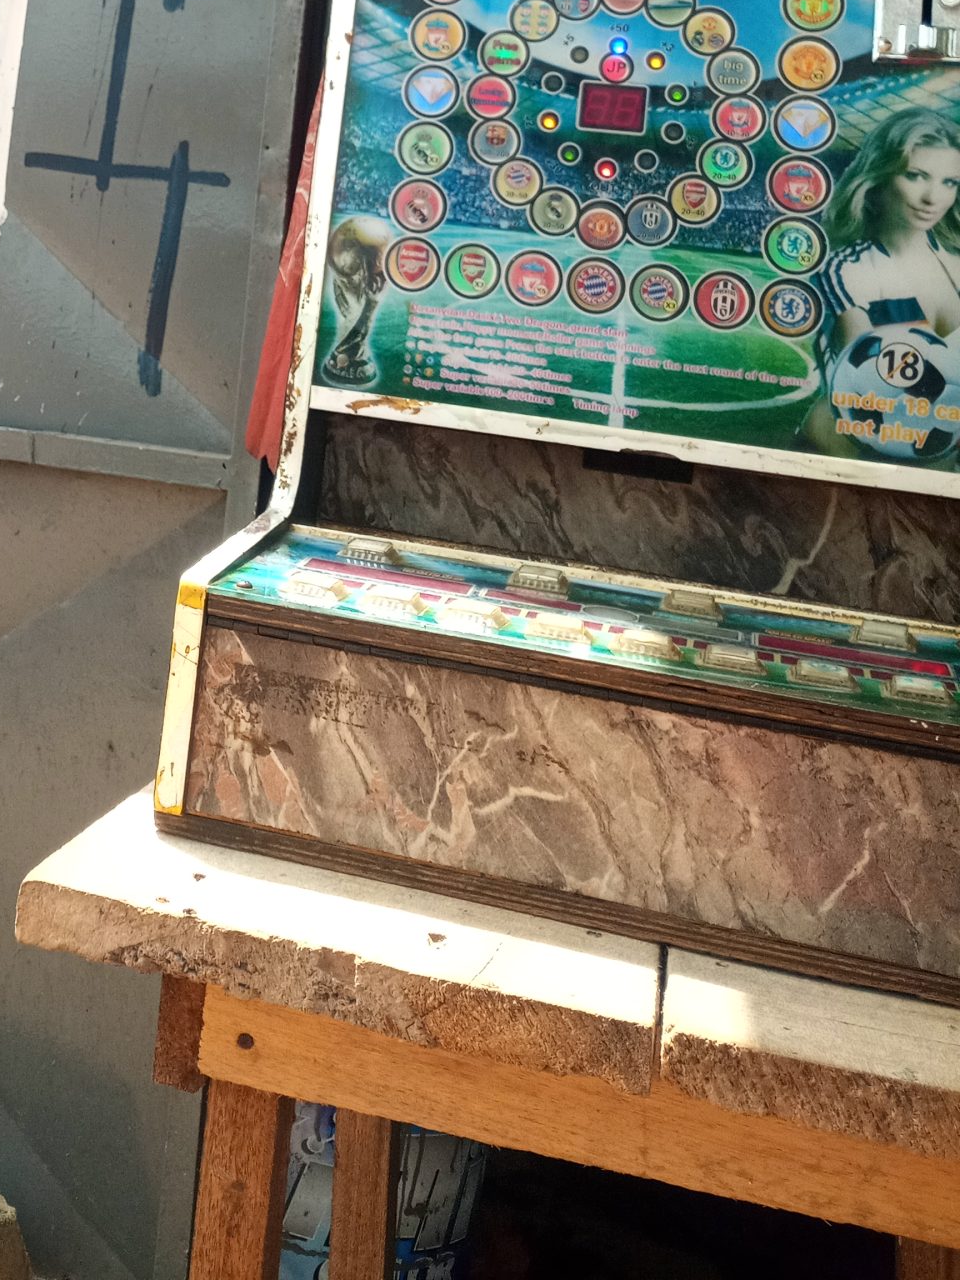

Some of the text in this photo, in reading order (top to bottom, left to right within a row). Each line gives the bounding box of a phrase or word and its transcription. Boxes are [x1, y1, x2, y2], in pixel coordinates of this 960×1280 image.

[493, 39, 519, 52] Free
[606, 62, 627, 73] JP
[723, 60, 745, 73] big
[718, 74, 748, 87] time
[602, 328, 628, 340] slam
[535, 344, 553, 355] the
[633, 357, 661, 369] enter
[663, 361, 682, 372] the
[683, 364, 709, 376] next
[710, 367, 744, 380] round
[745, 372, 758, 382] of
[758, 374, 778, 385] the
[779, 376, 811, 389] game
[882, 349, 920, 381] 18
[412, 377, 443, 391] Super
[573, 398, 610, 413] Timing
[832, 391, 897, 414] under
[904, 396, 931, 418] 18
[836, 418, 929, 449] not play
